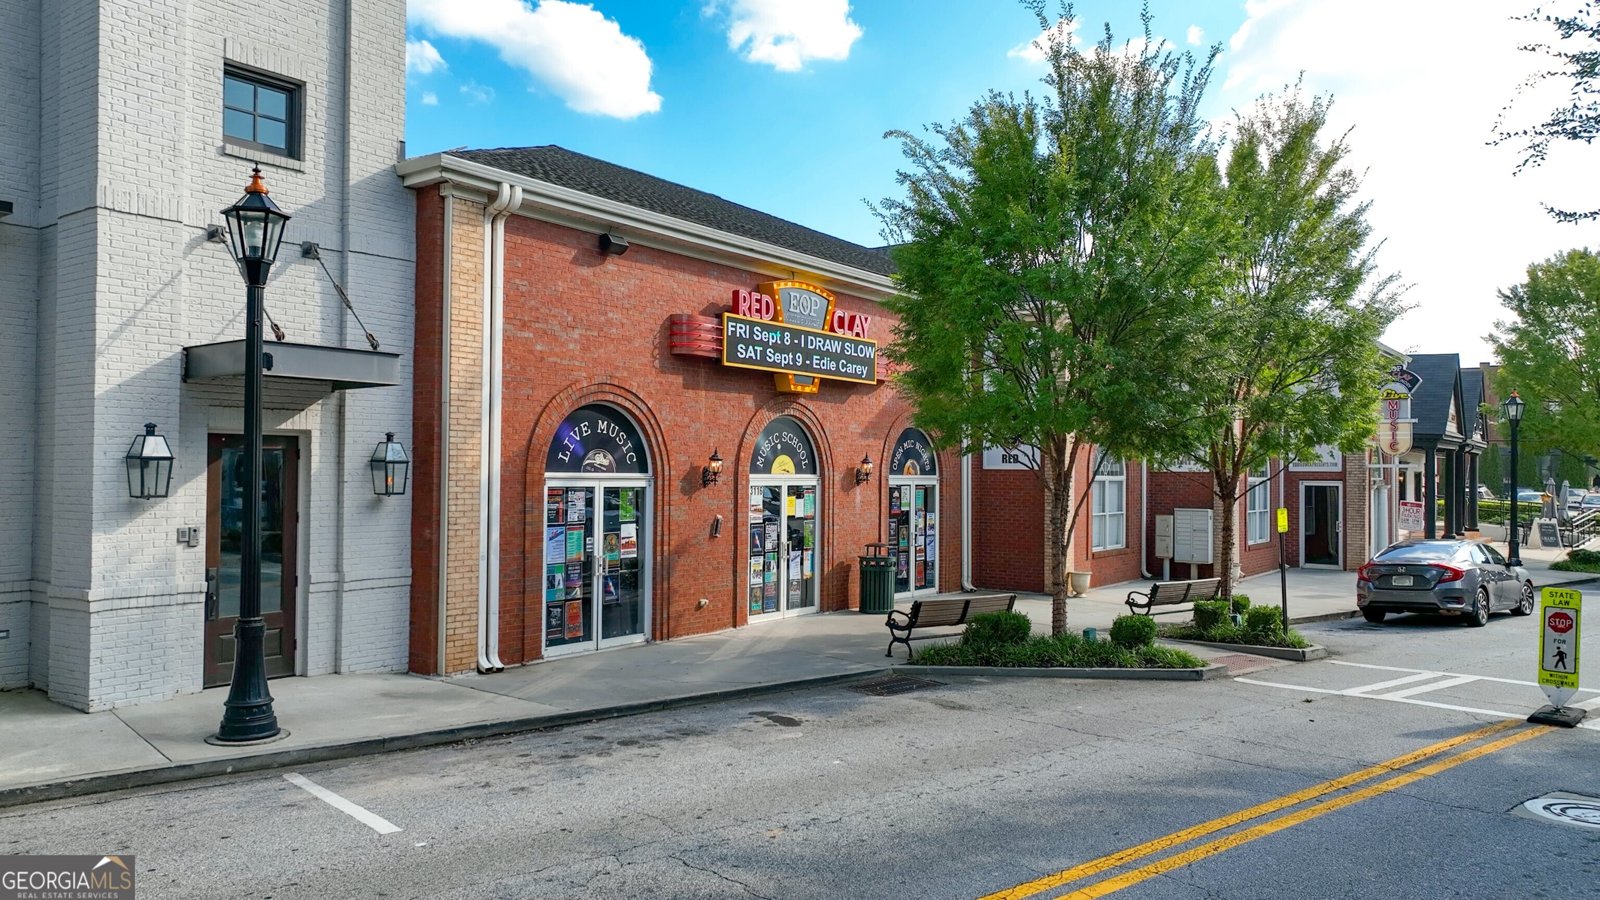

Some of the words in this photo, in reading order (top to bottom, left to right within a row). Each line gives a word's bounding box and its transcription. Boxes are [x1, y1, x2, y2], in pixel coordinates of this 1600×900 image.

[739, 289, 774, 320] RED
[789, 292, 820, 317] EOP
[728, 321, 750, 339] FRI
[753, 326, 781, 346] Sept
[783, 331, 791, 346] 8
[801, 334, 805, 348] I
[807, 335, 842, 354] DRAW
[844, 342, 875, 359] SLOW
[834, 310, 871, 339] CLAY
[737, 343, 763, 360] SAT
[766, 348, 793, 367] Sept
[795, 352, 803, 366] 9
[813, 355, 836, 371] Edie
[839, 359, 868, 378] Carey
[1387, 399, 1399, 453] MUSIC
[558, 421, 591, 464] LIVE
[597, 420, 637, 464] MUSIC
[756, 432, 780, 468] MUSIC
[782, 431, 809, 469] SCHOOL
[892, 446, 904, 470] OPEN
[903, 439, 915, 450] MIC
[915, 442, 931, 471] NIGHTS
[1001, 453, 1019, 464] RED
[1548, 591, 1574, 600] STATE
[1549, 617, 1572, 628] STOP
[1542, 678, 1575, 688] CROSSWALK
